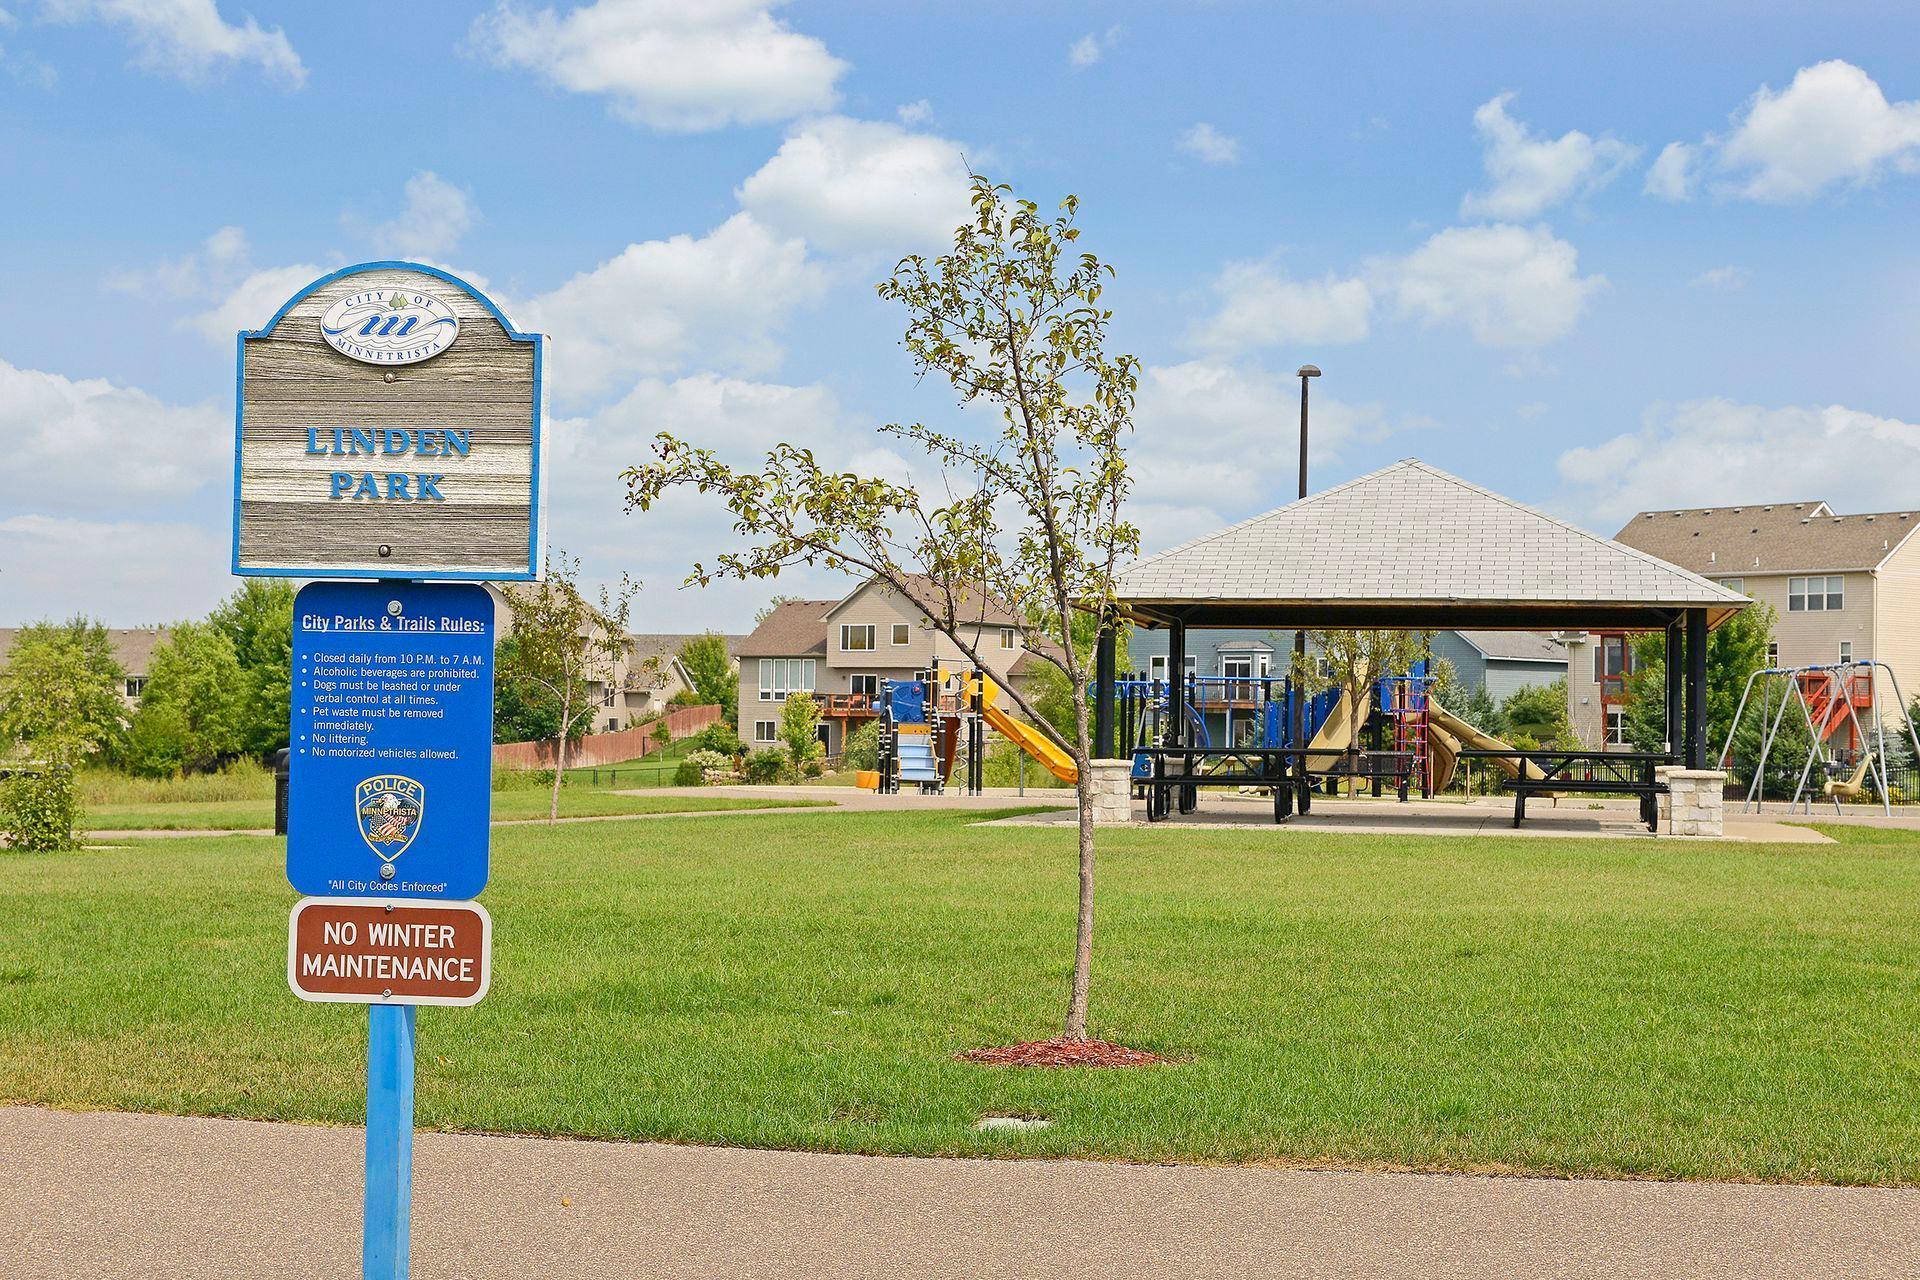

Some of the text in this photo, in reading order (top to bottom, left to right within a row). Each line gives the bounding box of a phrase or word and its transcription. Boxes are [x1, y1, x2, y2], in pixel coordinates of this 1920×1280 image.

[345, 291, 434, 308] CITY OF
[335, 338, 441, 361] MINNETRISTA
[304, 427, 473, 456] LINDEN
[329, 472, 446, 500] PARK
[302, 614, 485, 632] City Parks & Trails Rules:
[313, 652, 485, 666] Closed daily from 10 P.M. to 7 A.M.
[313, 666, 480, 680] Alcoholic beverages are prohibited.
[313, 679, 461, 692] Dogs must be leashed or under
[314, 693, 438, 705] verbal control at all times.
[313, 706, 444, 718] Pet waste must be removed
[313, 719, 375, 732] immediately.
[312, 733, 369, 746] No littering.
[312, 746, 459, 760] No motorized vehicles allowed.
[362, 778, 418, 797] POLICE
[347, 880, 367, 894] City
[369, 880, 399, 892] Codes
[323, 921, 456, 949] NO WINTER
[302, 953, 475, 982] MAINTENANCE
